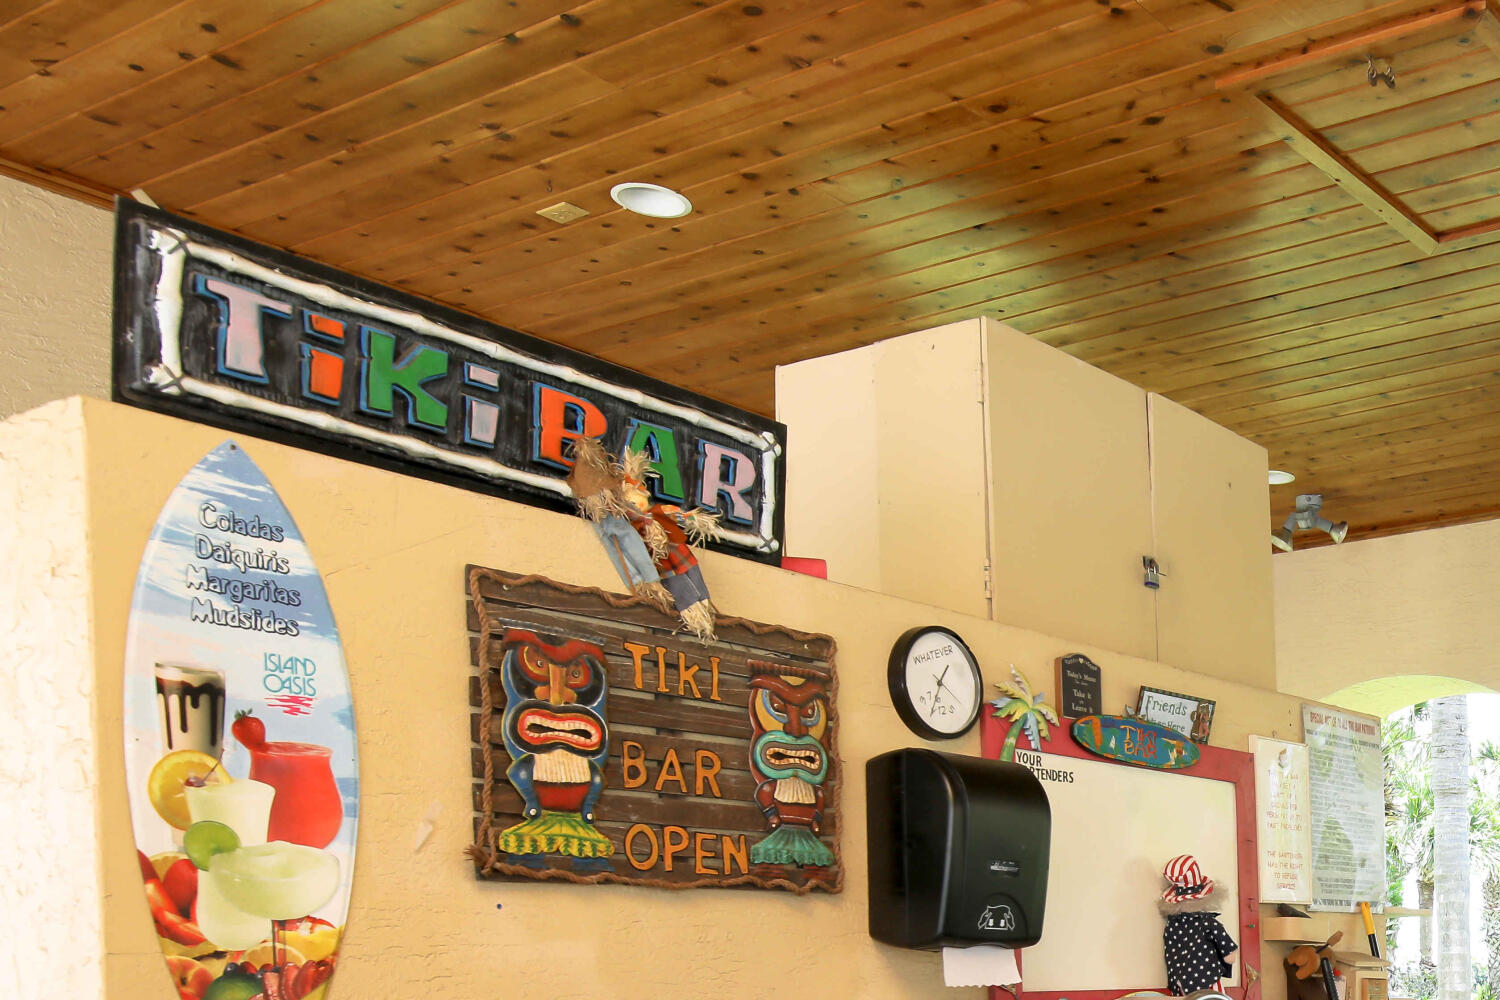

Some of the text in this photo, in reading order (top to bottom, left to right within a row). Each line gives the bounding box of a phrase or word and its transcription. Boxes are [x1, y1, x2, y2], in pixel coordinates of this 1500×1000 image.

[532, 381, 756, 527] BAR
[200, 502, 285, 542] Coladas
[194, 533, 290, 574] Daiquiris
[186, 564, 302, 606] Margaritas
[190, 597, 299, 637] Mudslides
[263, 652, 317, 676] ISLAND
[623, 641, 721, 701] TIKI
[913, 645, 954, 665] WHATEVER
[263, 674, 317, 697] OASIS
[1145, 695, 1188, 717] Friends
[622, 740, 722, 798] BAR
[1016, 752, 1042, 767] YOUR
[1123, 740, 1157, 759] BAR
[1030, 766, 1074, 783] TENDERS
[624, 823, 749, 875] OPEN
